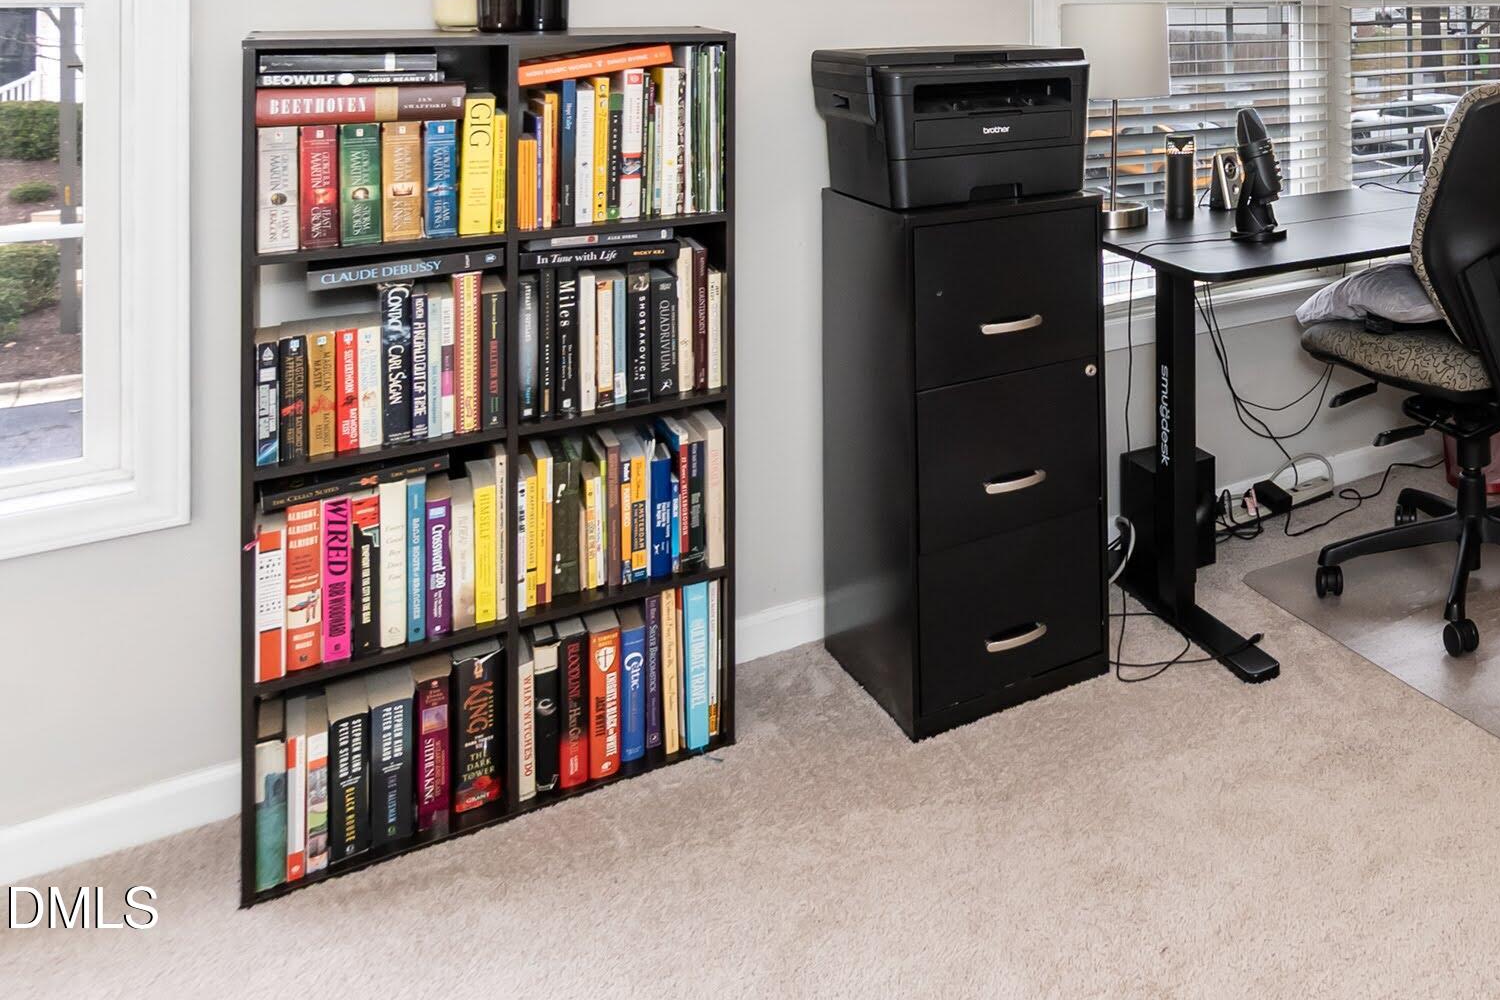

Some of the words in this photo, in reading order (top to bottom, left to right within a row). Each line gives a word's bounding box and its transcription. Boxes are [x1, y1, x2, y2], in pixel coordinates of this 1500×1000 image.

[263, 74, 336, 86] BEOWULF
[269, 96, 367, 116] BEETHOVEN
[470, 103, 492, 148] GIG
[564, 116, 572, 130] Valley
[983, 126, 1010, 134] brother
[270, 154, 281, 191] MARTIN
[311, 152, 322, 188] MARTIN
[350, 150, 362, 186] MARTIN
[394, 146, 404, 180] MARTIN
[432, 146, 443, 181] MARTIN
[310, 206, 323, 239] CROWS
[352, 204, 363, 236] SWORDS
[536, 255, 548, 265] In
[550, 254, 573, 264] Tune
[574, 252, 597, 262] with
[598, 249, 618, 262] Life
[320, 268, 378, 284] CLAUDE
[382, 260, 442, 277] DEBUSSY
[415, 298, 424, 318] NIVEN
[559, 280, 576, 328] Miles
[638, 296, 646, 381] SHOSTAKOVICH
[659, 300, 670, 372] QUADRIVIUM
[388, 344, 404, 370] CARL
[414, 362, 426, 380] OUT
[296, 355, 304, 394] MAGICIAN
[313, 360, 322, 390] MASTER
[323, 352, 332, 392] MAGICIAN
[344, 350, 354, 394] SILVERTHORN
[388, 372, 408, 405] SAGAN
[414, 382, 426, 393] OF
[414, 394, 426, 416] TIME
[1159, 364, 1170, 467] smugdesk
[350, 407, 358, 436] RAYMOND
[272, 498, 284, 506] THE
[286, 491, 312, 502] CELLO
[313, 486, 340, 496] SUITES
[412, 518, 421, 544] BANJO
[480, 493, 490, 541] HIMSELF
[638, 502, 646, 548] AMSTERDAM
[326, 498, 348, 576] WIRED
[432, 524, 446, 572] Crossword
[362, 544, 370, 568] SYMPHONY
[412, 545, 421, 571] ROOTS
[328, 581, 346, 596] BOB
[362, 586, 370, 598] CITY
[435, 572, 446, 588] 200
[412, 576, 421, 620] BRANCHES
[328, 596, 346, 638] WOODWARD
[690, 620, 706, 672] ULTIMATE
[568, 642, 580, 698] BLOODLINE
[524, 674, 532, 708] WHAT
[606, 671, 618, 700] KNIGHTS
[690, 673, 706, 709] TRAVEL
[464, 681, 494, 734] KING
[595, 696, 606, 712] JACK
[606, 706, 618, 728] BLACK
[382, 707, 392, 732] PETER
[393, 704, 404, 738] STEPHEN
[595, 714, 606, 738] WHYTE
[338, 722, 348, 747] PETER
[351, 718, 362, 752] STEPHEN
[382, 732, 392, 762] STRAUB
[393, 739, 404, 758] KING
[524, 710, 532, 760] WITCHES
[568, 727, 581, 754] GRAIL
[606, 732, 618, 756] WHITE
[338, 749, 348, 778] STRAUB
[351, 754, 362, 773] KING
[424, 738, 434, 776] STEPHEN
[466, 758, 492, 772] DARK
[470, 750, 487, 762] THE
[524, 763, 532, 776] DO
[388, 775, 396, 788] THE
[462, 766, 496, 782] TOWER
[345, 786, 356, 812] BLACK
[424, 776, 434, 805] KING
[388, 790, 396, 824] TALISMAN
[345, 814, 356, 842] HOUSE
